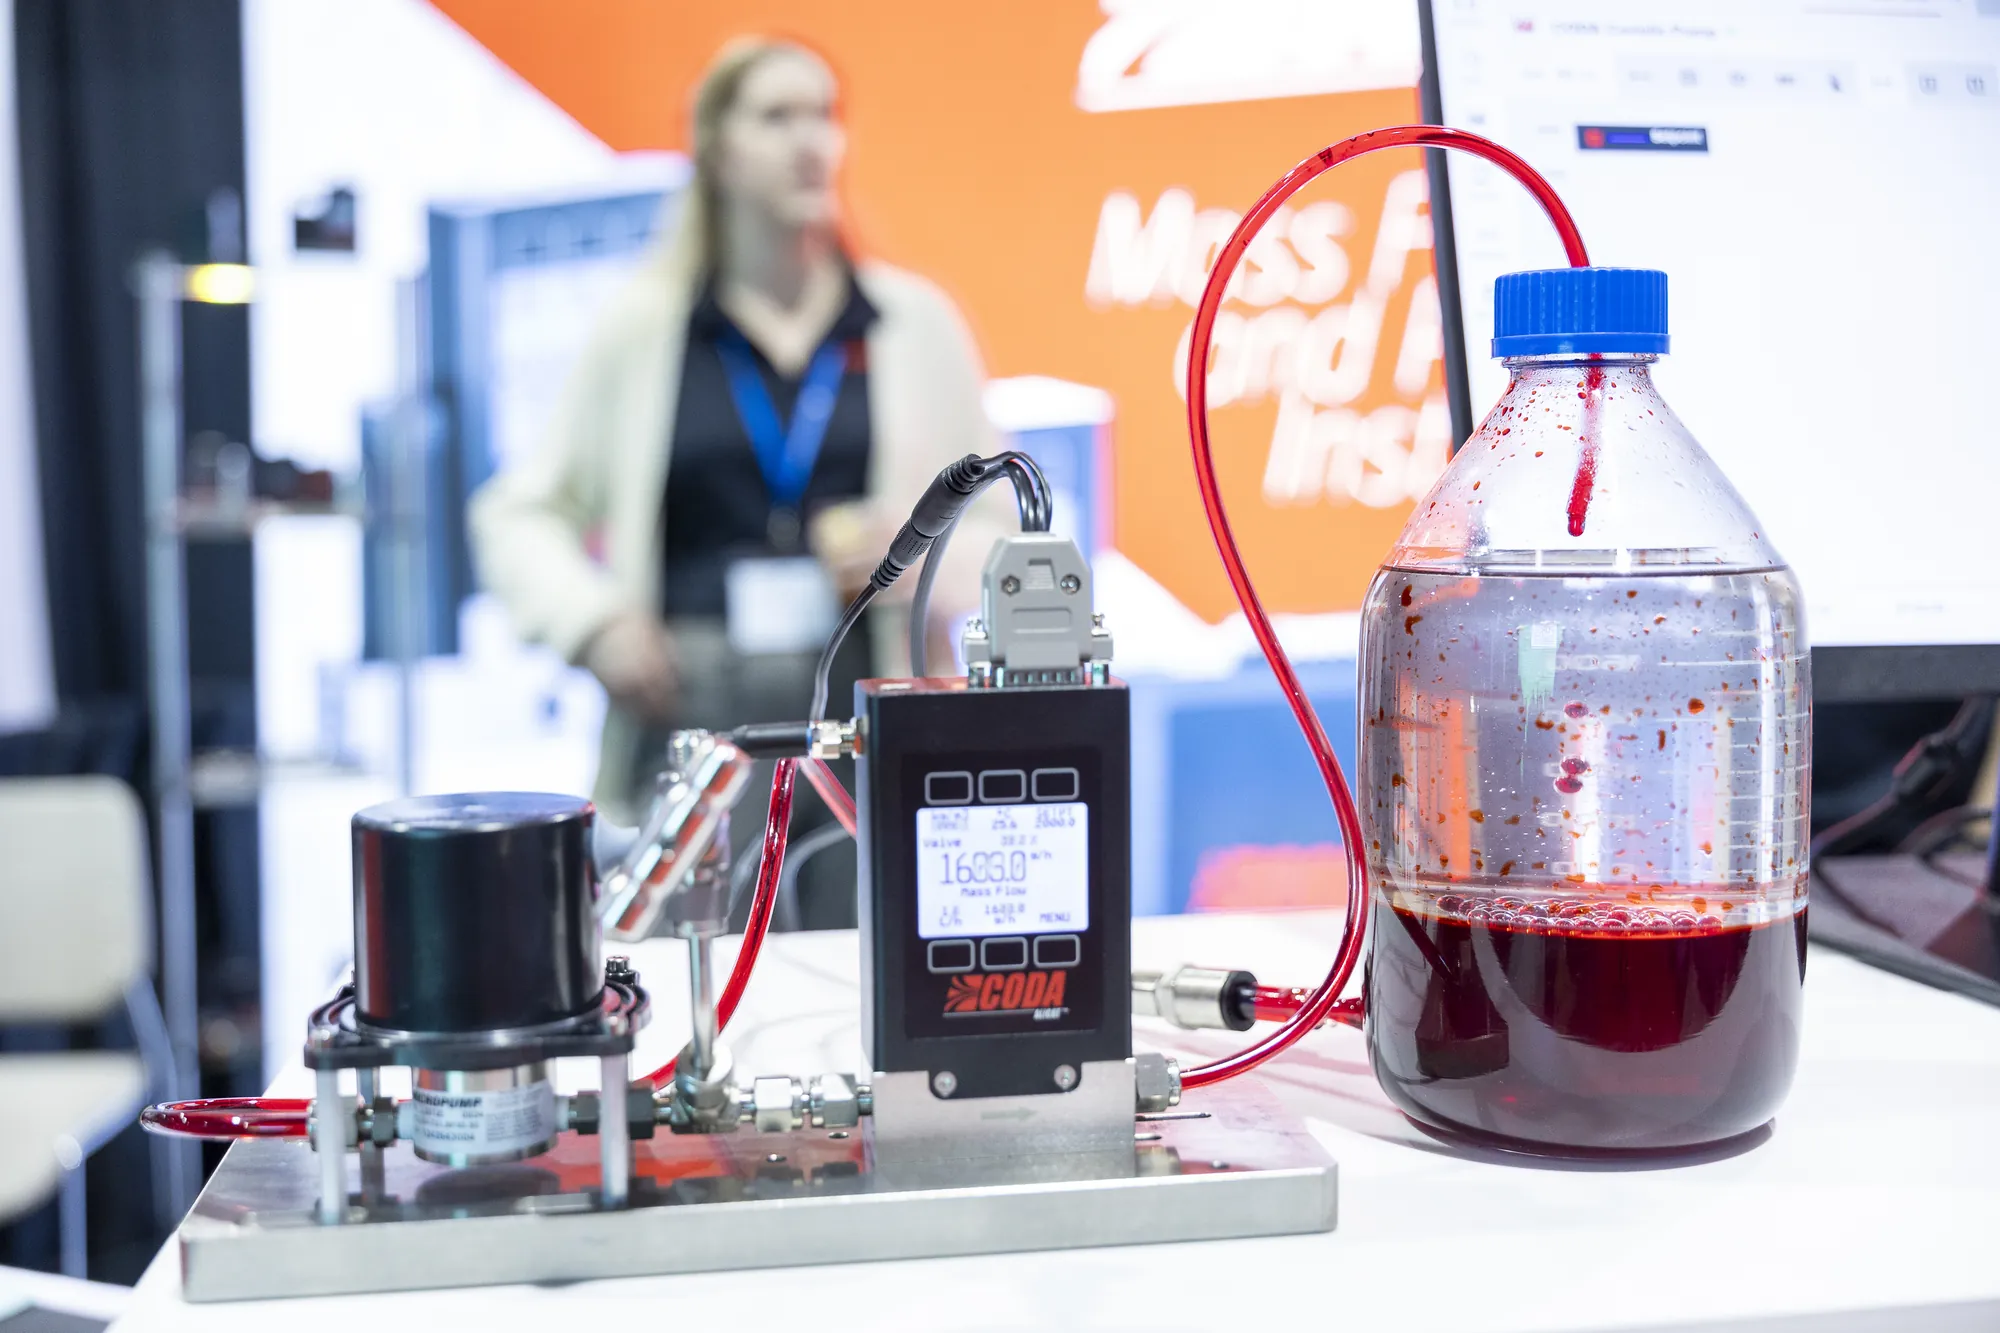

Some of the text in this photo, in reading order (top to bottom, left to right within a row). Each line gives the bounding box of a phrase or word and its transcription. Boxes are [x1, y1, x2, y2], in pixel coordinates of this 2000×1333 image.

[1086, 187, 1355, 310] Mass
[1173, 288, 1385, 408] and
[1039, 911, 1071, 923] MENU
[979, 970, 1067, 1011] CODA
